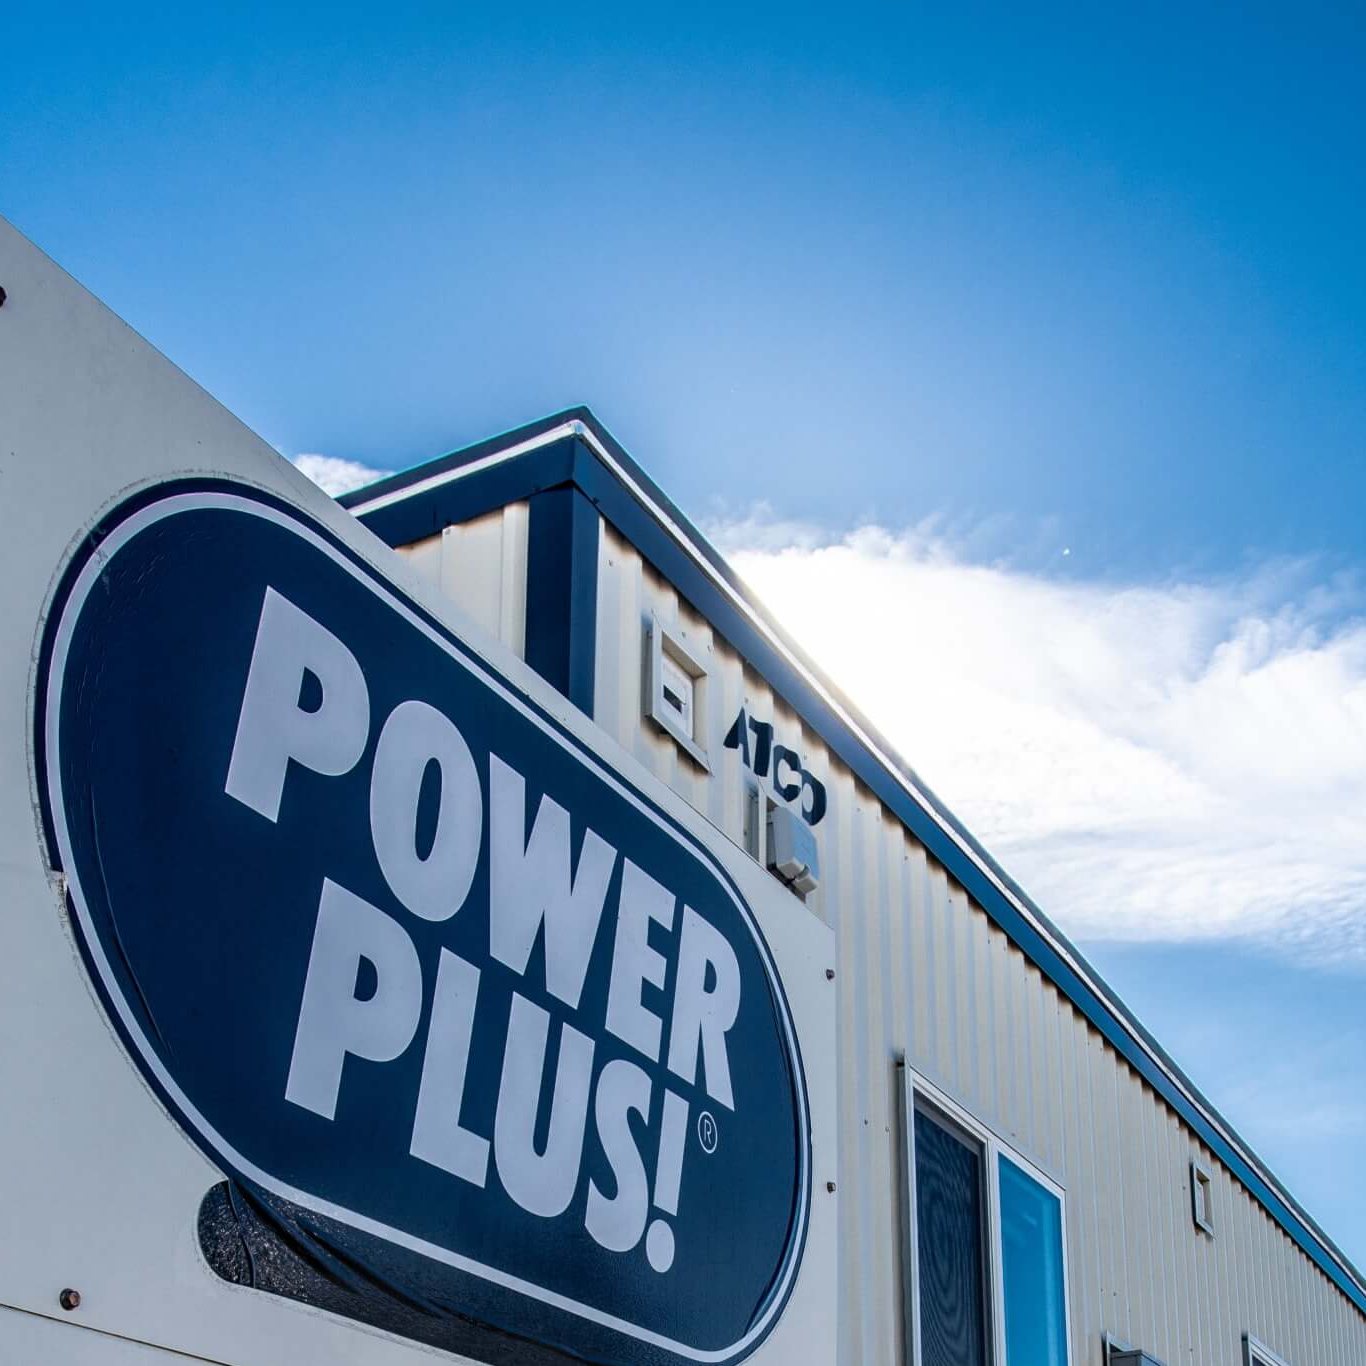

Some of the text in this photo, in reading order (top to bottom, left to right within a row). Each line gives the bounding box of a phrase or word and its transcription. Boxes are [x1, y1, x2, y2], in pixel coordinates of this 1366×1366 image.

[225, 585, 741, 1111] POWER
[723, 706, 827, 826] ATCO
[285, 877, 689, 1273] PLUS!
